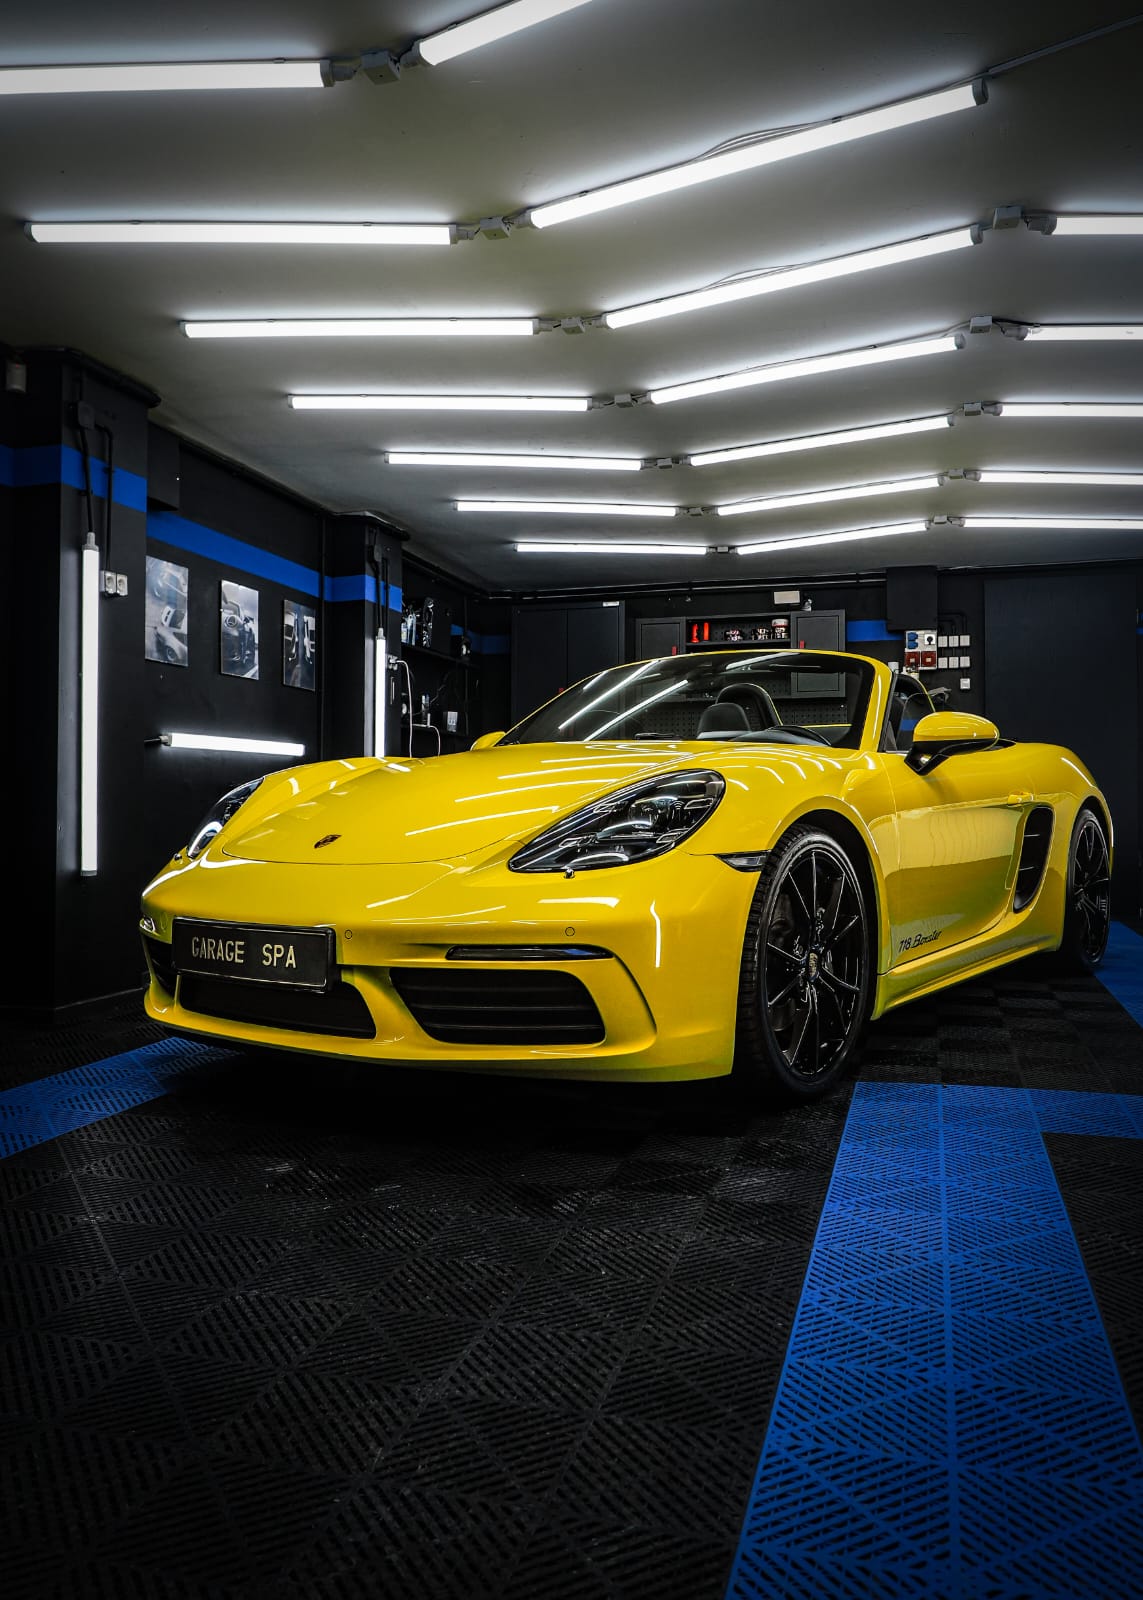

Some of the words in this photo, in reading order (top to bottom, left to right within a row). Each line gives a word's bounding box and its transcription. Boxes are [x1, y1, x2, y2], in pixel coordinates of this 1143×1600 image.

[191, 936, 246, 964] GARAGE
[262, 943, 297, 969] SPA
[898, 937, 912, 953] 718
